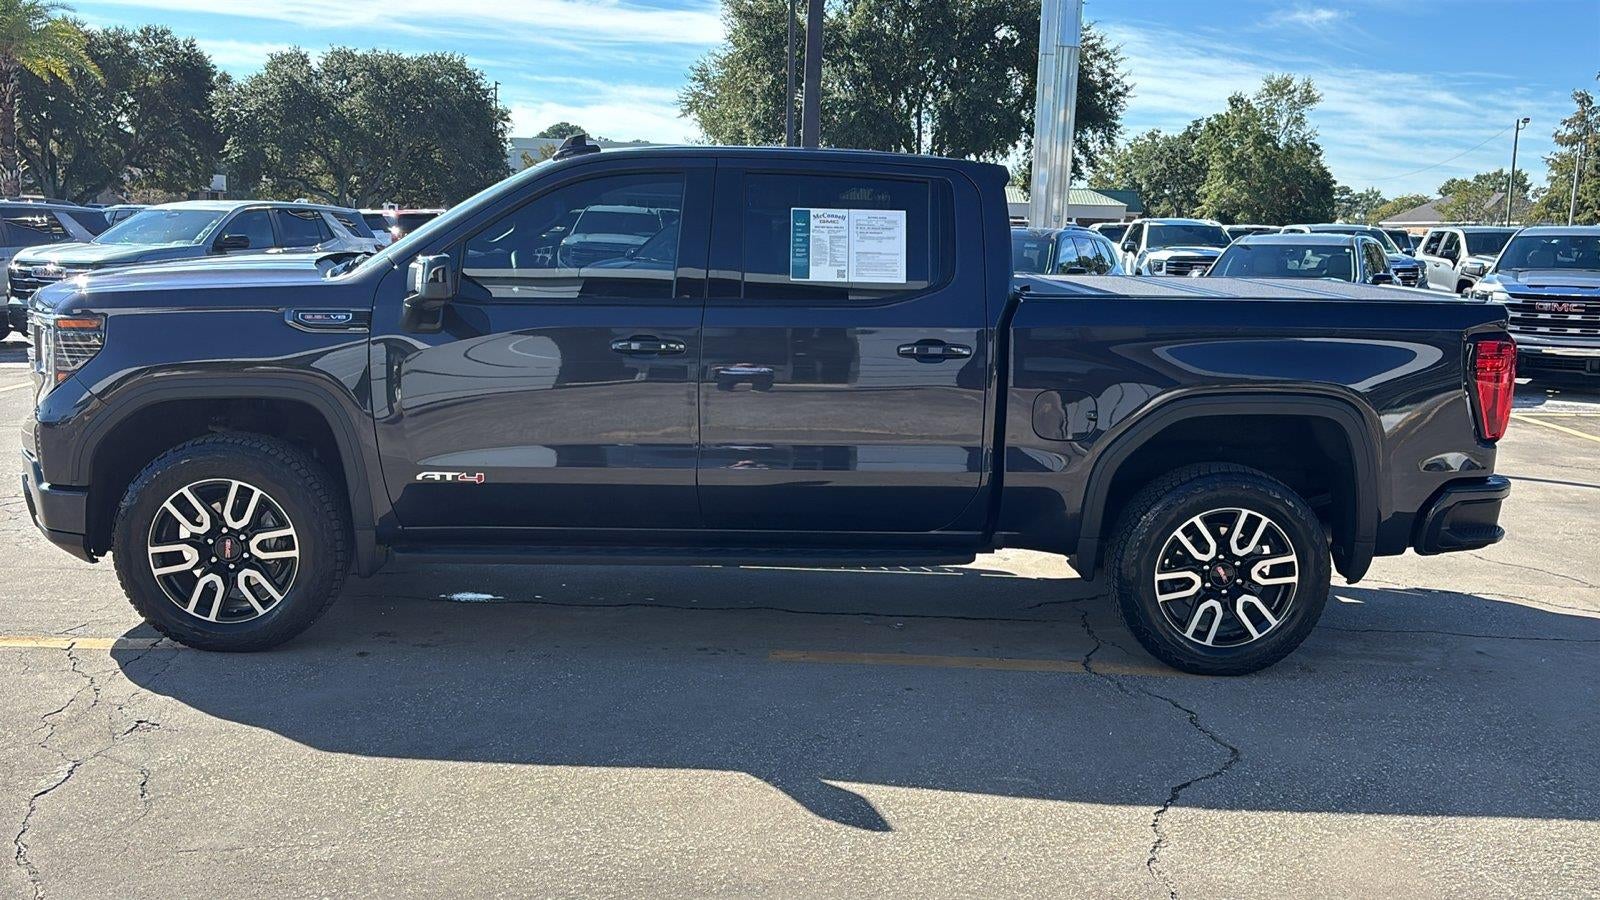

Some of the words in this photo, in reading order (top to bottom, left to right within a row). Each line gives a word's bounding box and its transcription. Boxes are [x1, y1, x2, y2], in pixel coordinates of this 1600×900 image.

[812, 212, 847, 221] McConnell
[1535, 301, 1586, 312] GMC
[416, 471, 485, 484] AT4
